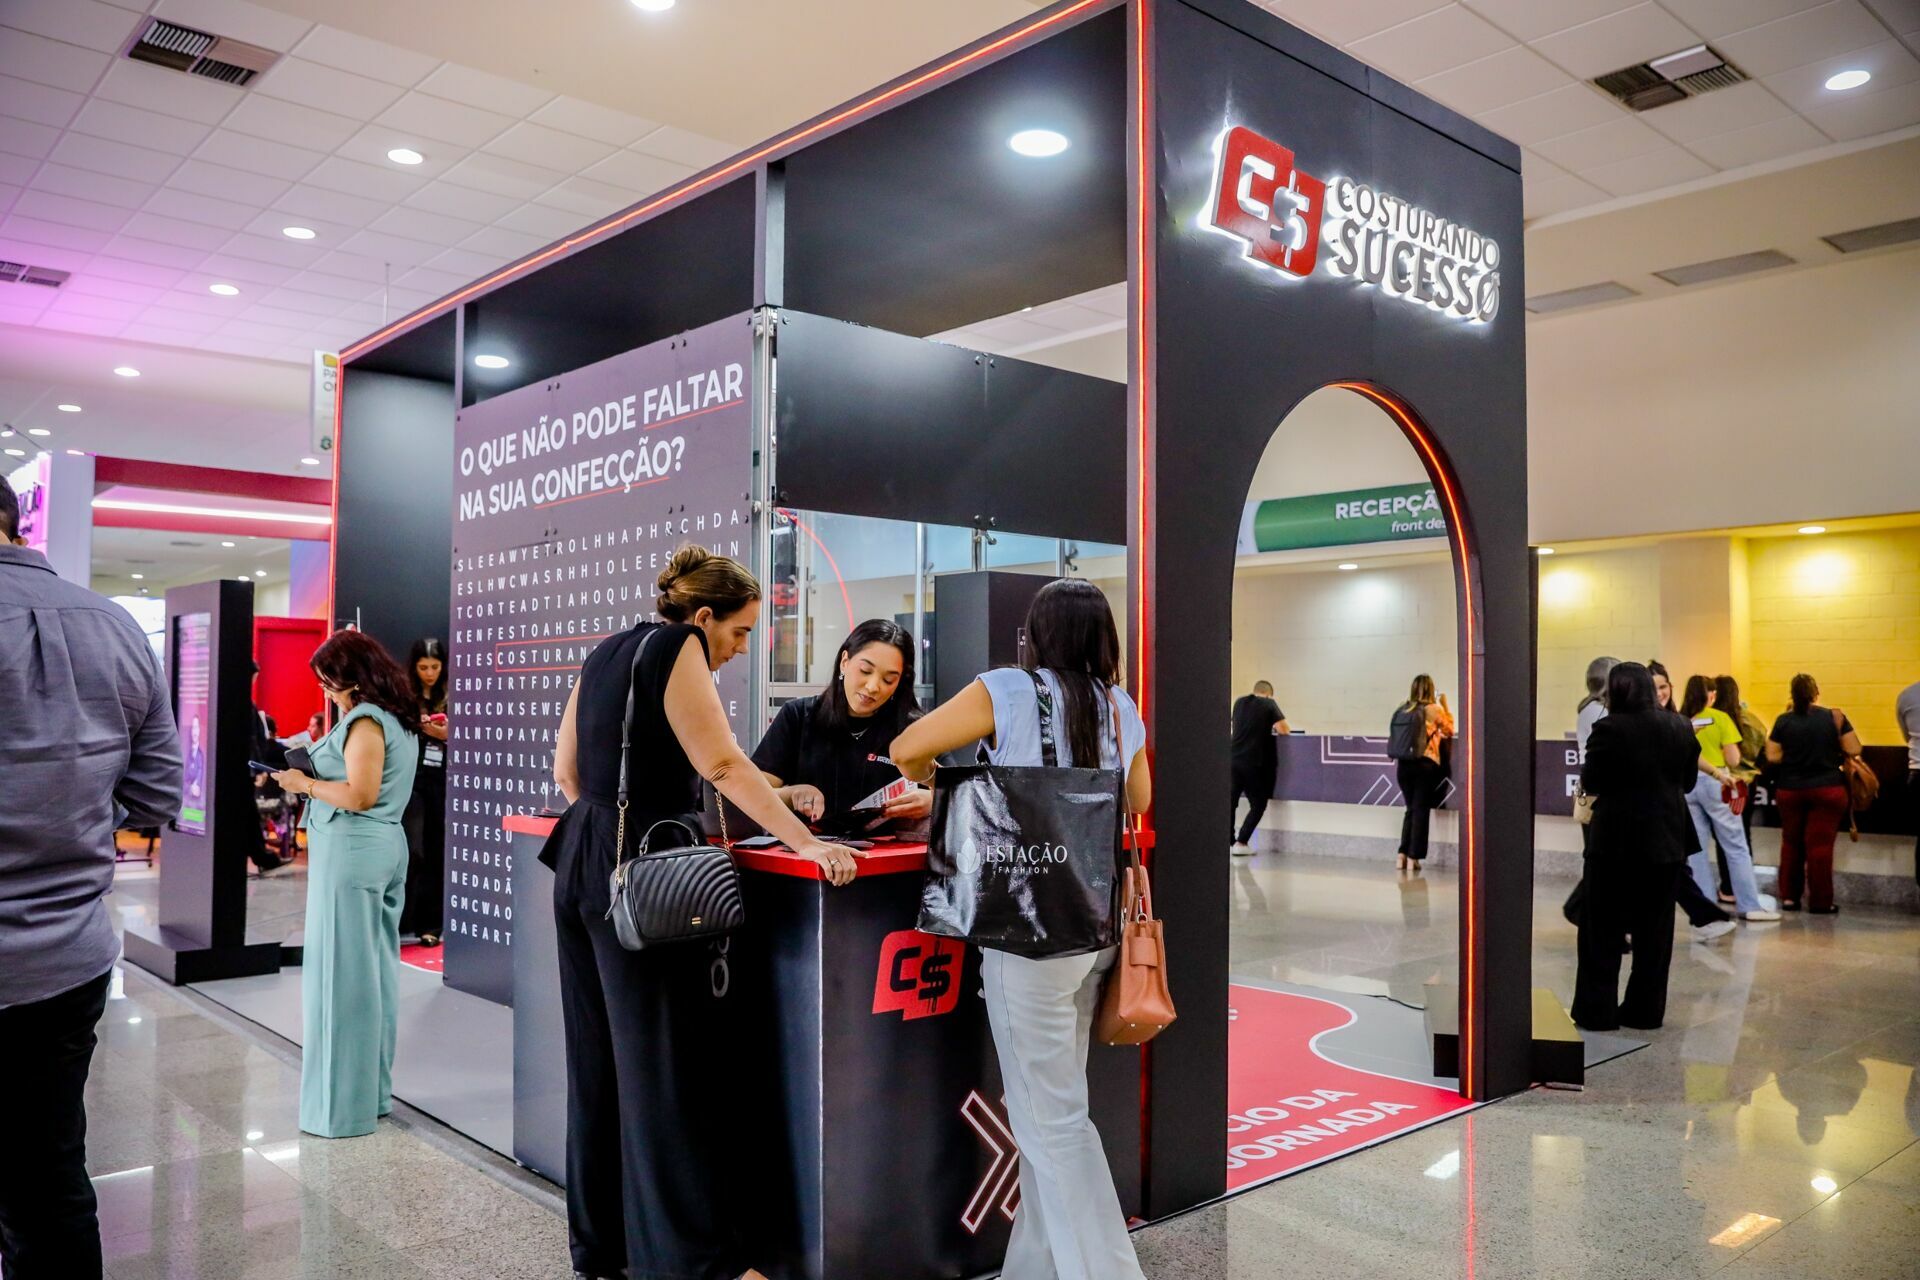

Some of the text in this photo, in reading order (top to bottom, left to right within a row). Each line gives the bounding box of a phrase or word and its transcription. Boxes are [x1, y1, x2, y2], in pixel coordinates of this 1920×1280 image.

[1334, 176, 1501, 270] COSTURANDO
[1332, 218, 1501, 322] SUCESSO
[460, 362, 744, 477] O QUE NÃO PODE FALTAR
[460, 435, 686, 521] NA SUA CONFECÇÃO?
[1391, 520, 1423, 533] front
[986, 841, 1068, 865] ESTAÇÃO
[998, 866, 1049, 874] FASHION
[1277, 1088, 1359, 1111] DA
